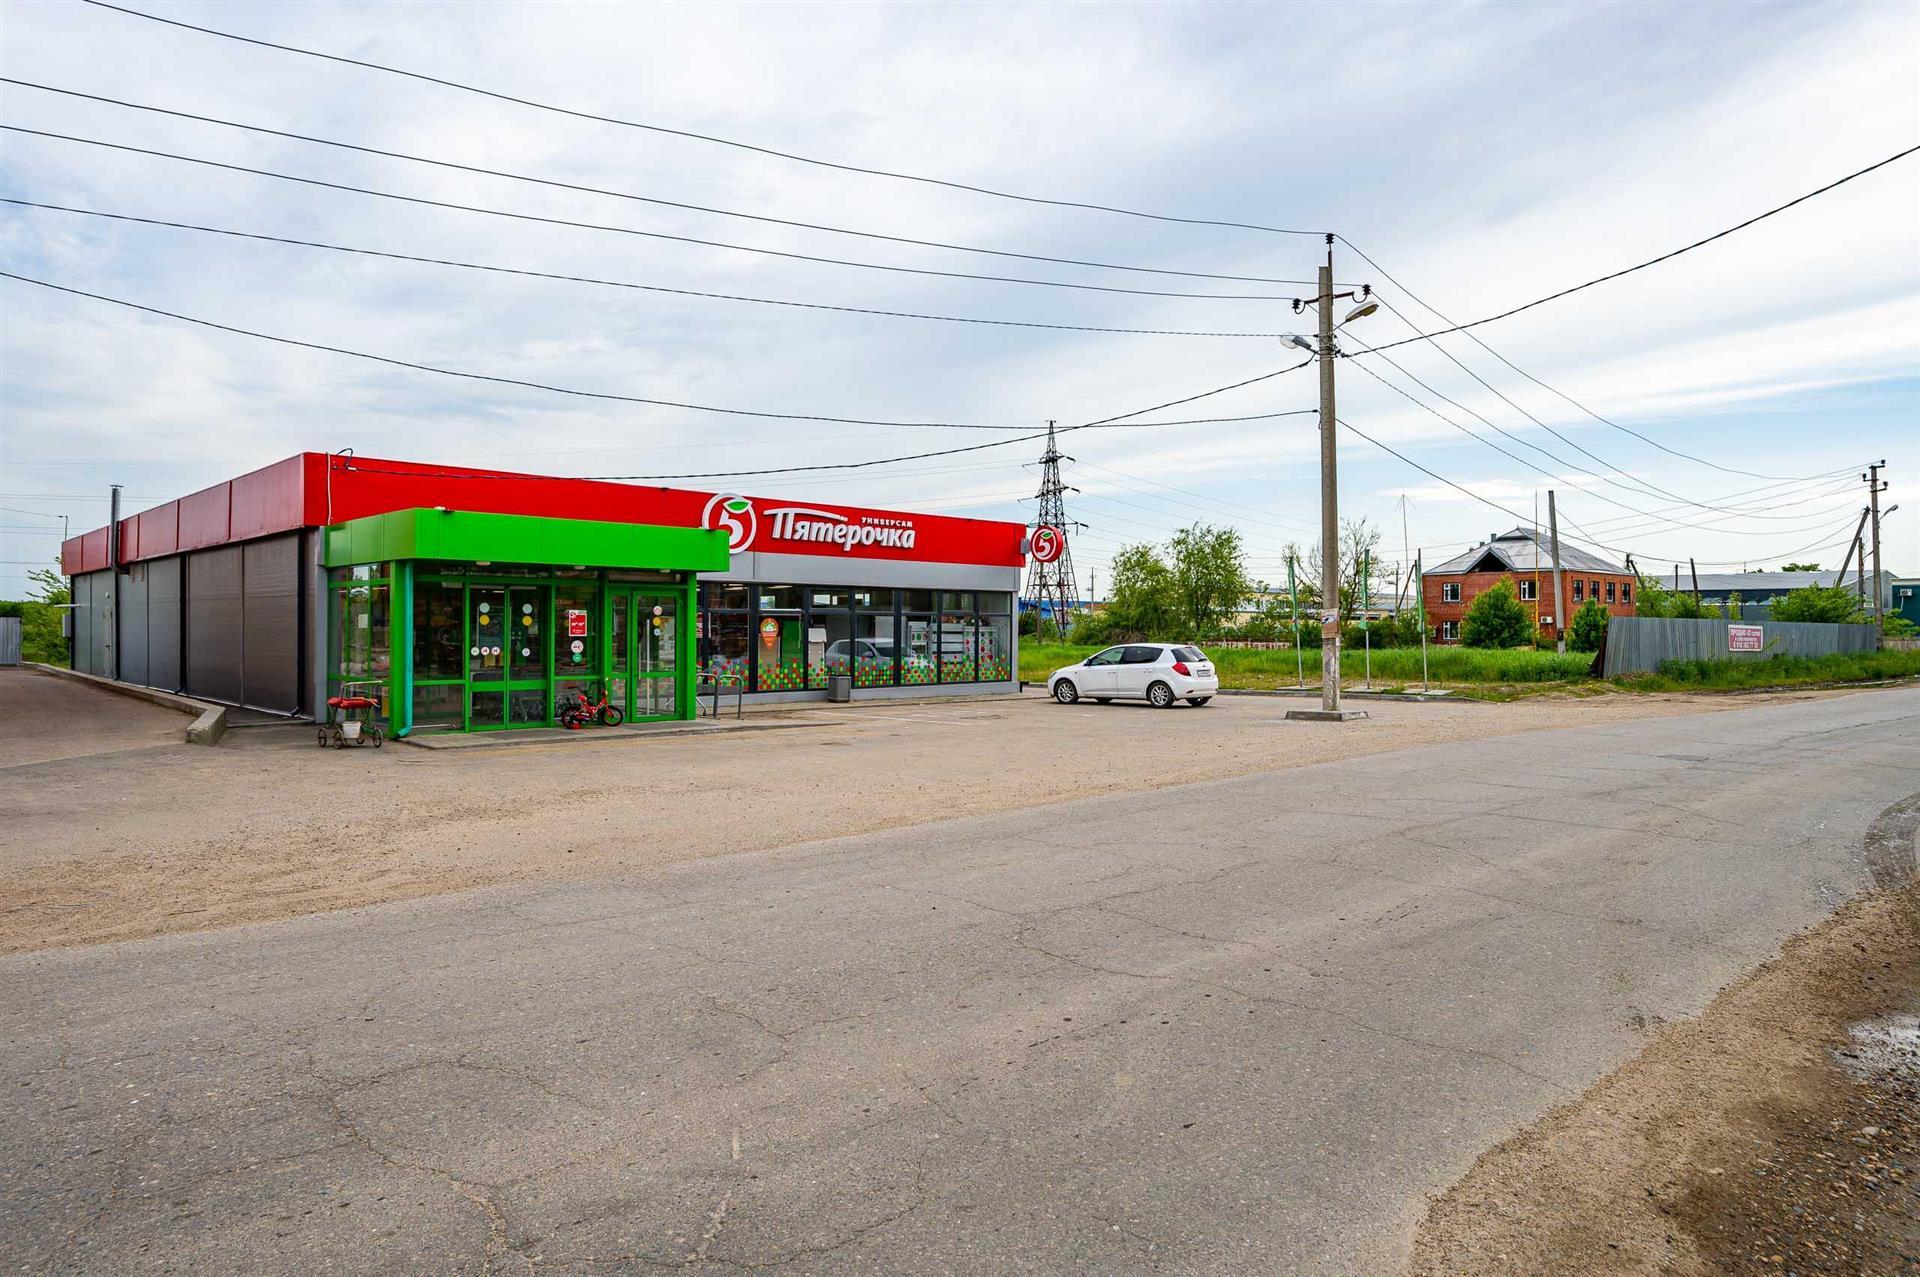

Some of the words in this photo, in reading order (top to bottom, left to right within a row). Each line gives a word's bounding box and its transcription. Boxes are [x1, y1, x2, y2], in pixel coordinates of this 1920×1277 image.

[718, 507, 744, 546] 5
[861, 517, 914, 528] УНИВЕРСАМ
[1037, 538, 1051, 558] 5
